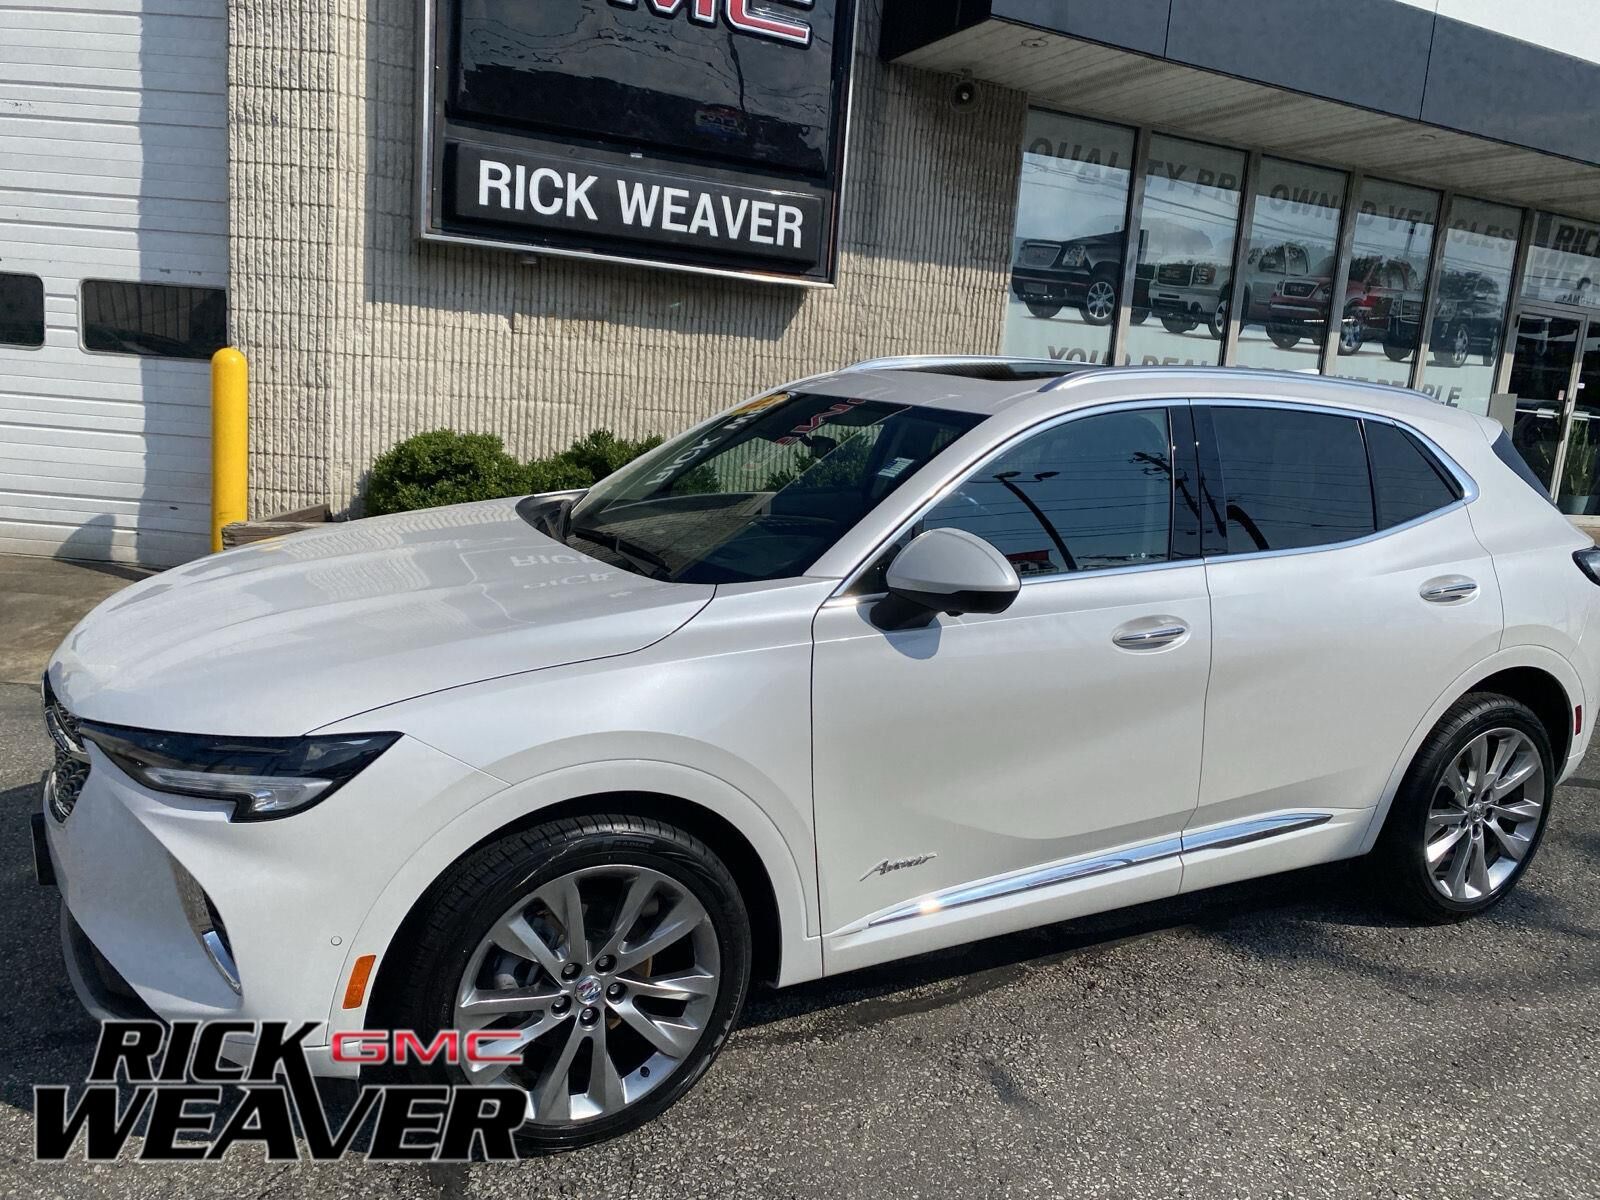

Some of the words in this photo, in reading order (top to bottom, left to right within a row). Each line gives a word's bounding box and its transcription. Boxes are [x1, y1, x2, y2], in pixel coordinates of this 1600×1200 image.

[478, 159, 598, 221] RICK
[616, 179, 803, 249] WEAVER
[1027, 137, 1187, 191] QUALTY
[1268, 183, 1377, 226] OWND
